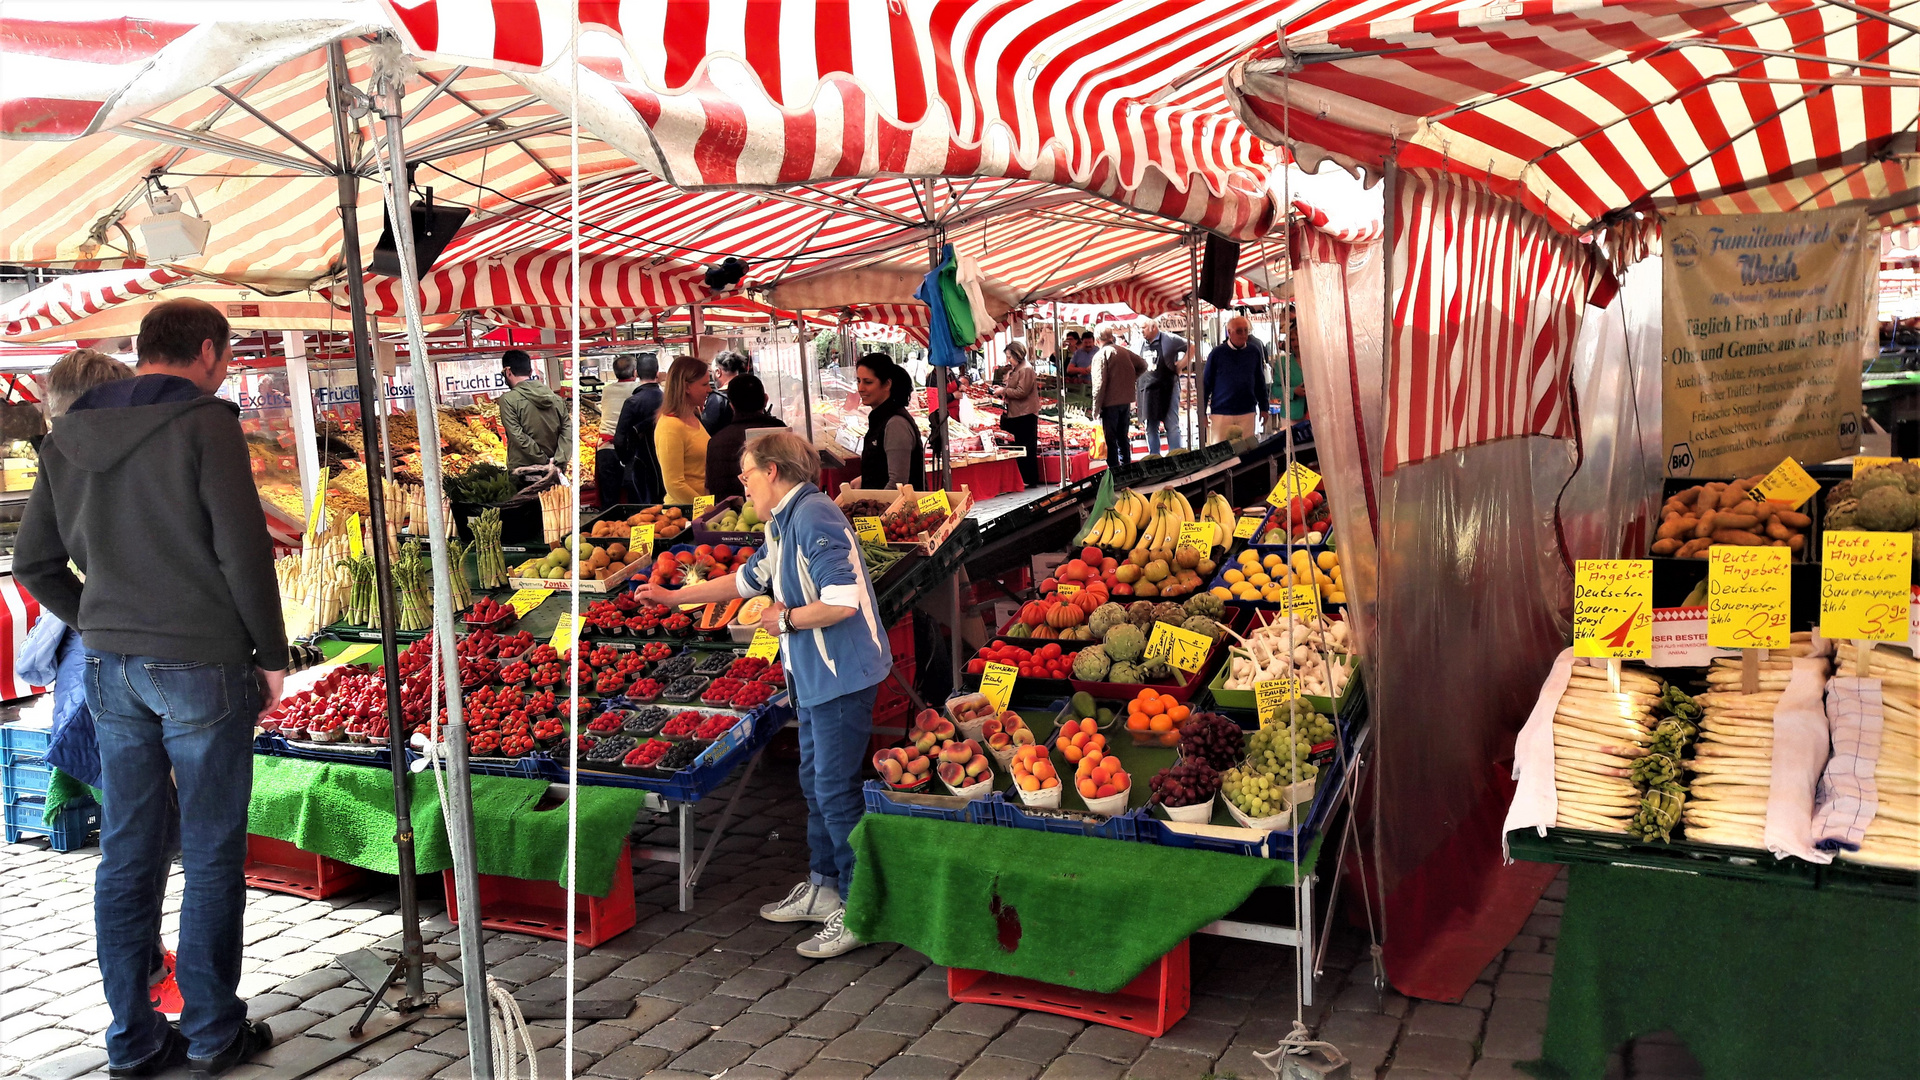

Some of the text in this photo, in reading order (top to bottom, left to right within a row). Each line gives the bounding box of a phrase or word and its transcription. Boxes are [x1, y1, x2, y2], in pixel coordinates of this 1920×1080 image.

[1709, 222, 1830, 255] Familienbetrieb
[1737, 252, 1800, 286] Weich
[1686, 317, 1731, 339] Täglich
[1735, 312, 1769, 331] Frisch
[1773, 309, 1793, 326] auf
[1700, 343, 1723, 361] und
[1728, 339, 1774, 358] Gemüse
[1778, 337, 1796, 352] aus
[446, 374, 490, 391] Frucht
[238, 392, 291, 409] Exotisc
[319, 385, 359, 402] Früch
[1827, 535, 1870, 548] Heute
[1712, 549, 1758, 563] Heute
[1578, 561, 1618, 572] Heute
[1724, 564, 1788, 580] Angebot!
[1589, 570, 1652, 585] Angebot!
